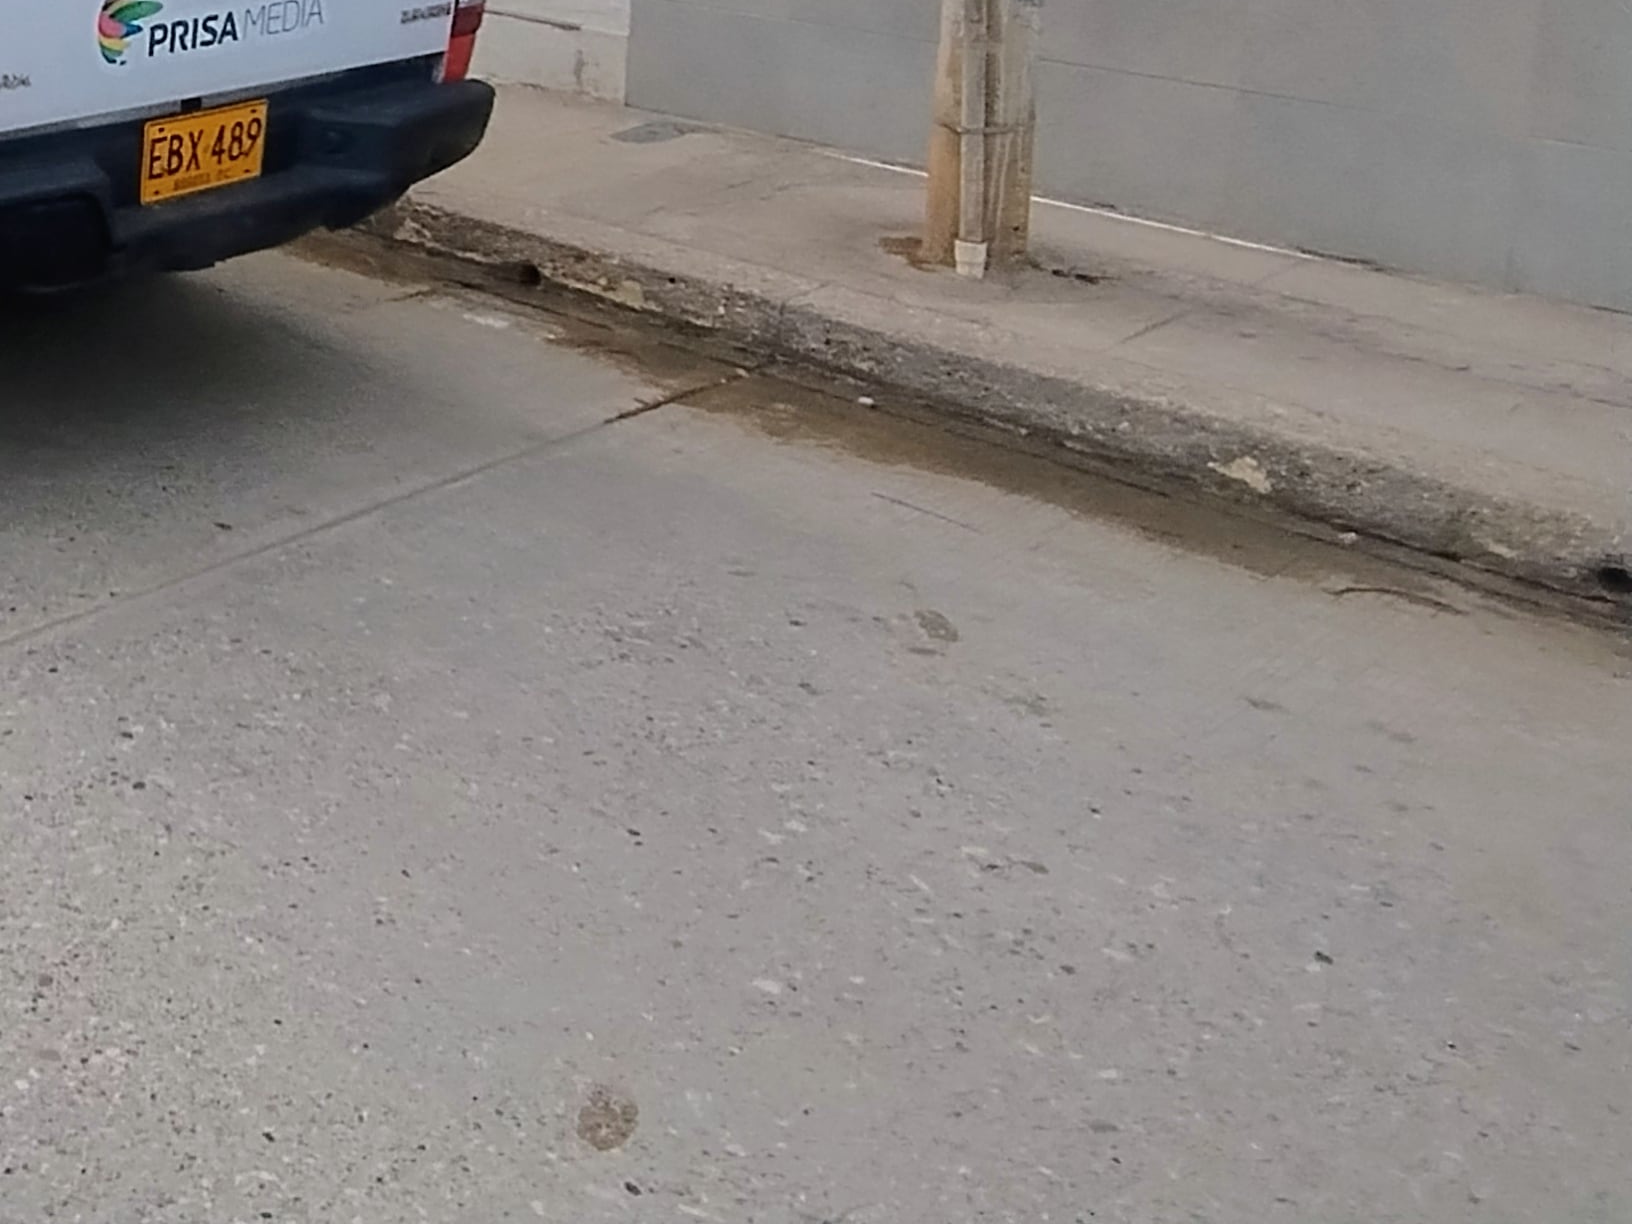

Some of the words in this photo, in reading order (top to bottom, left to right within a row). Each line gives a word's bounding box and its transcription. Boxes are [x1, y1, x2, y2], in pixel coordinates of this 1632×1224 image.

[148, 10, 238, 57] PRISA
[148, 128, 204, 180] EBX
[211, 117, 262, 165] 489
